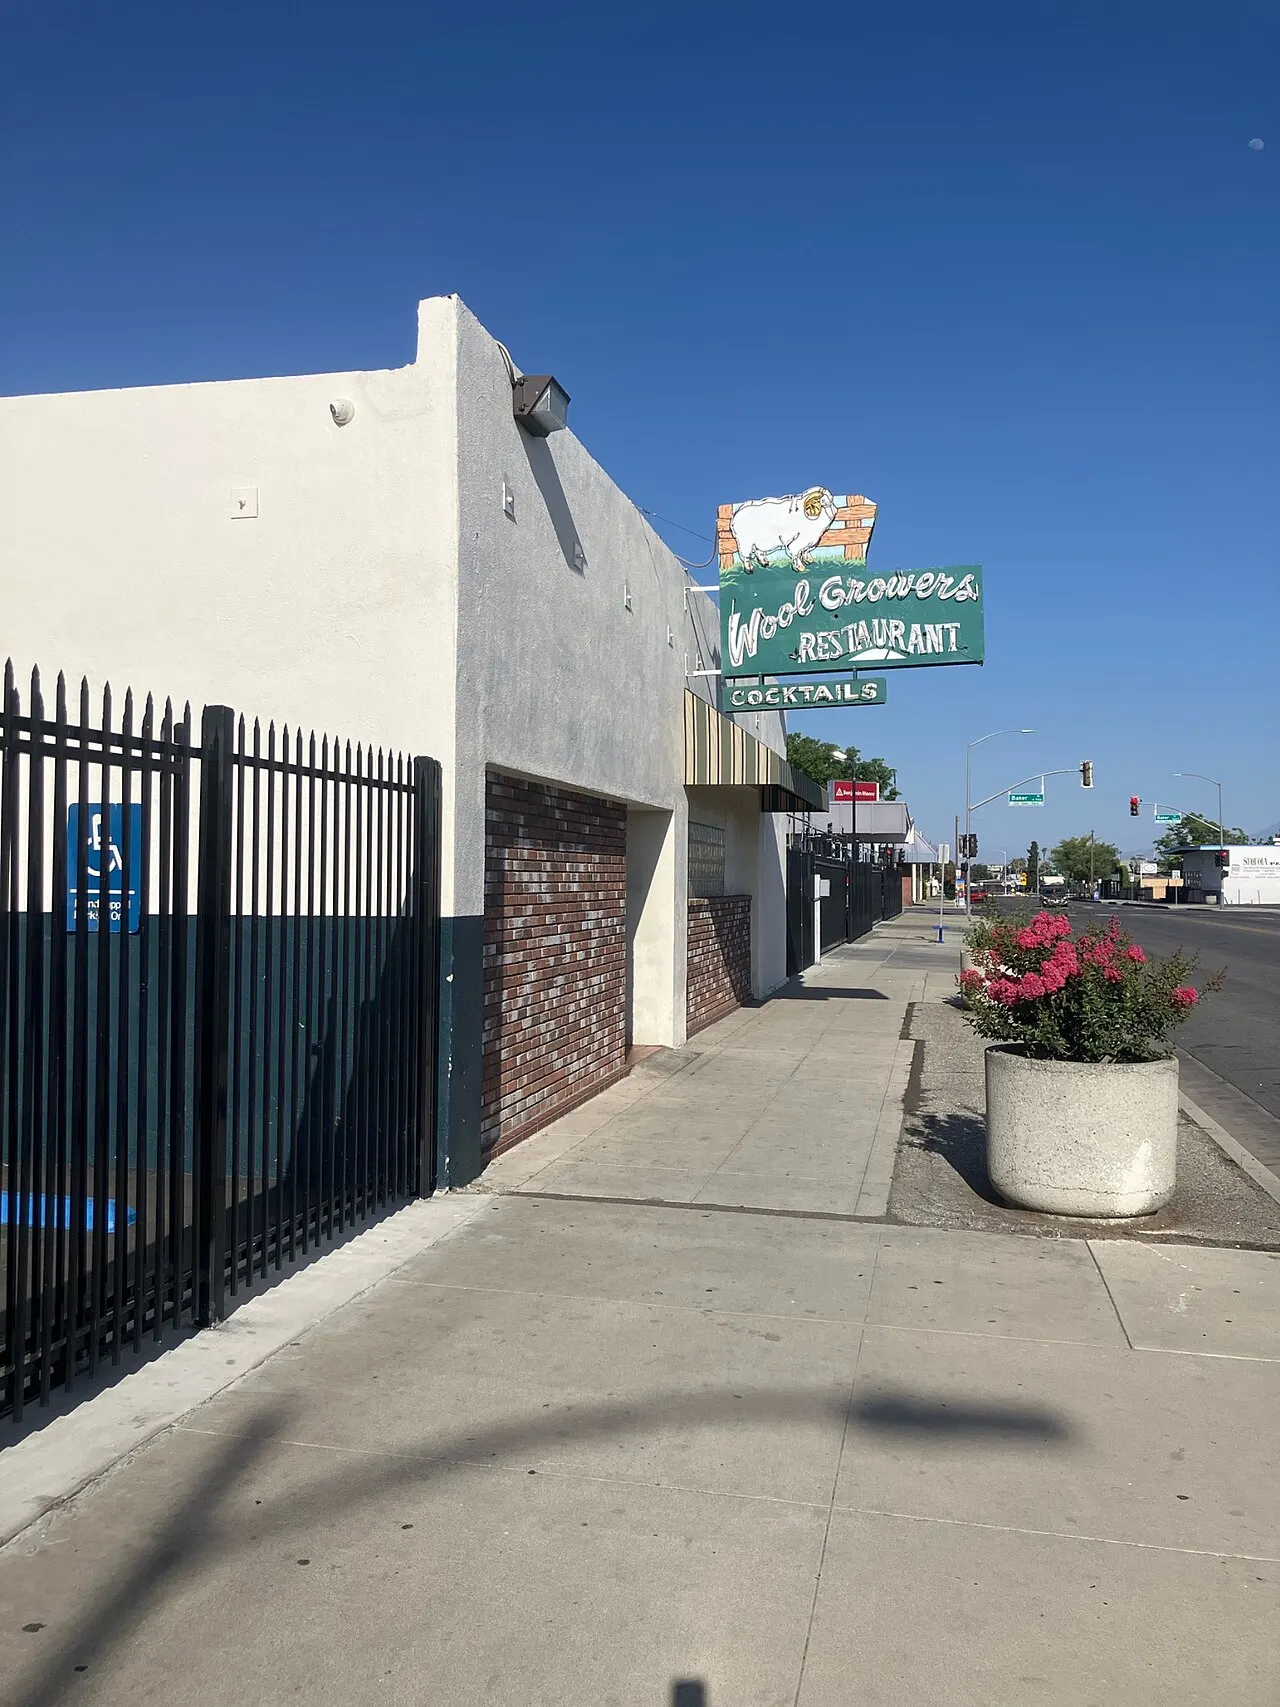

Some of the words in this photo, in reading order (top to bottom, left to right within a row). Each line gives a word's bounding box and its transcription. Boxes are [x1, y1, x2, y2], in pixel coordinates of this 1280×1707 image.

[728, 578, 815, 668] Wool
[818, 572, 979, 611] Growers
[796, 618, 961, 664] RESTAURANT
[730, 682, 878, 707] COCKTAILS
